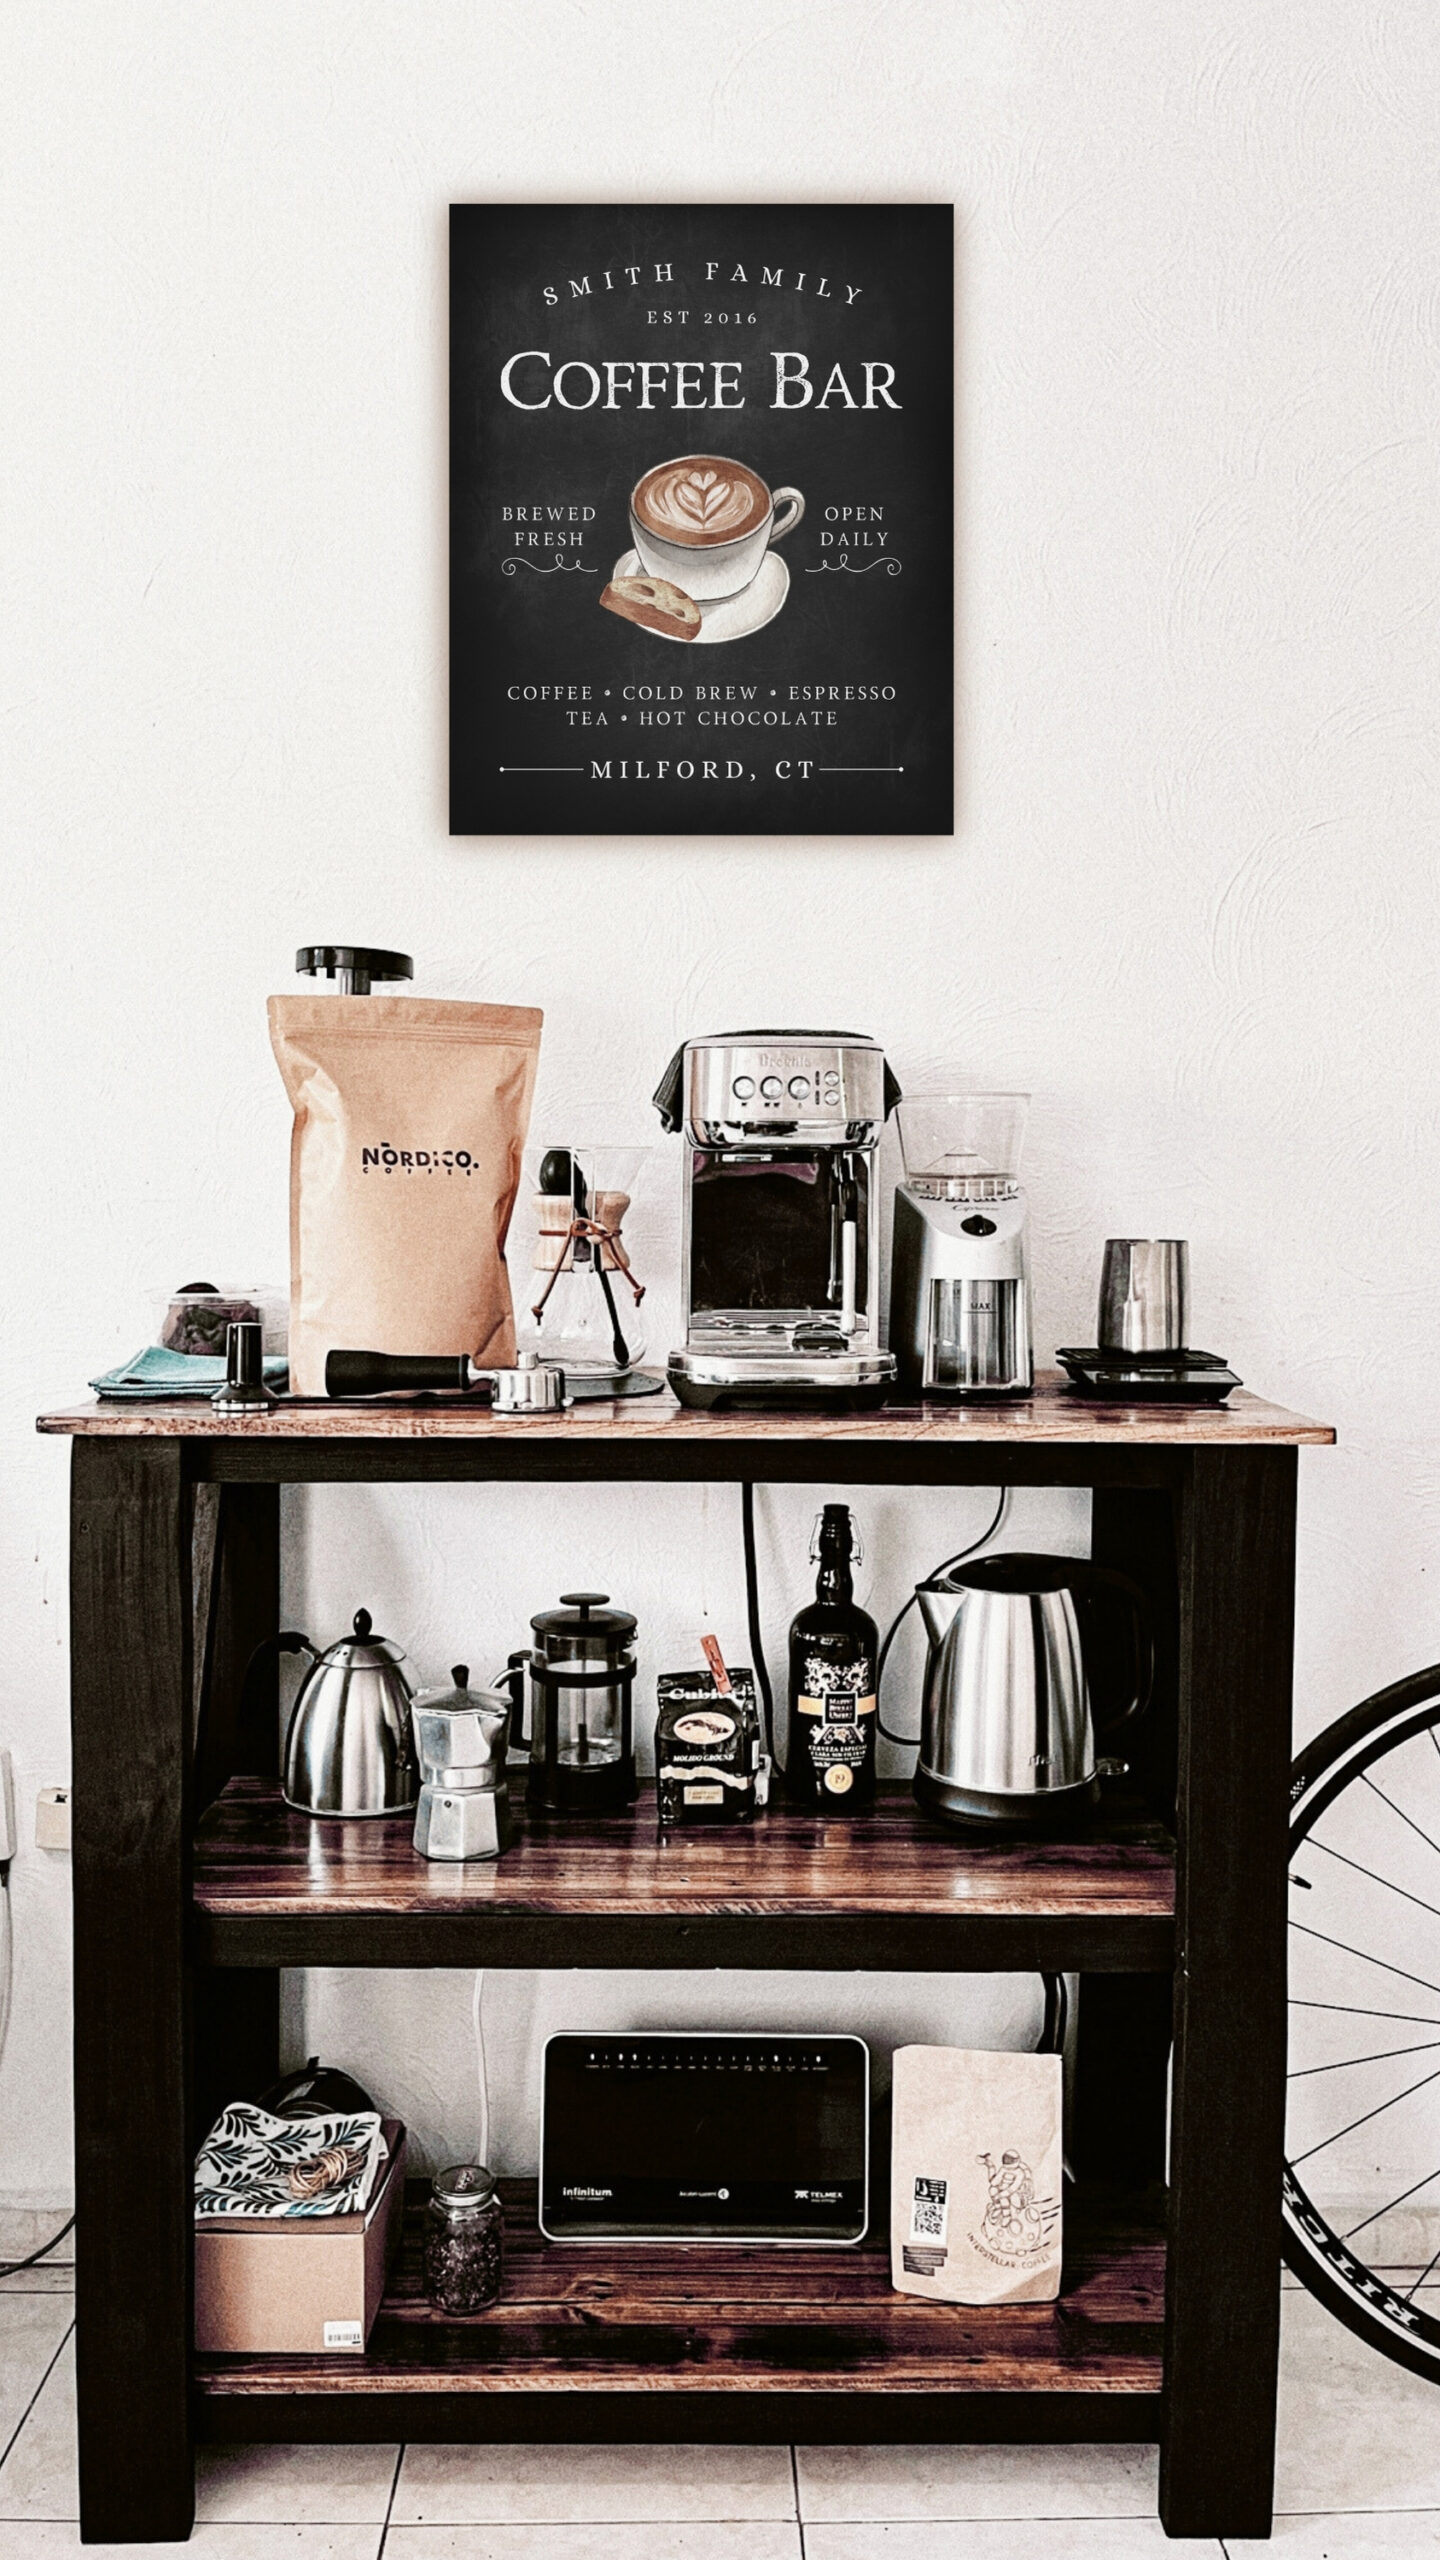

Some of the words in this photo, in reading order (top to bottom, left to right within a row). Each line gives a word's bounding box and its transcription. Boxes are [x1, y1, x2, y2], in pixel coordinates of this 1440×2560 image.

[543, 263, 674, 306] SMITH
[705, 262, 863, 305] FAMILY
[647, 310, 690, 324] EST
[704, 312, 757, 325] 2016
[500, 350, 746, 411] COFFEE
[768, 351, 903, 411] BAR
[502, 506, 596, 521] BREWED
[824, 506, 884, 522] OPEN
[514, 531, 584, 546] FRESH
[820, 531, 890, 546] DAILY
[507, 686, 593, 701] COFFEE
[622, 685, 684, 701] COLD
[695, 686, 758, 701] BREW
[789, 685, 897, 701] ESPRESSO
[566, 711, 609, 726] TEA
[639, 710, 686, 726] HOT
[697, 710, 838, 726] CHOCOLATE
[590, 760, 757, 782] MILFORD,
[775, 760, 814, 780] CT
[563, 2187, 613, 2197] infinitum
